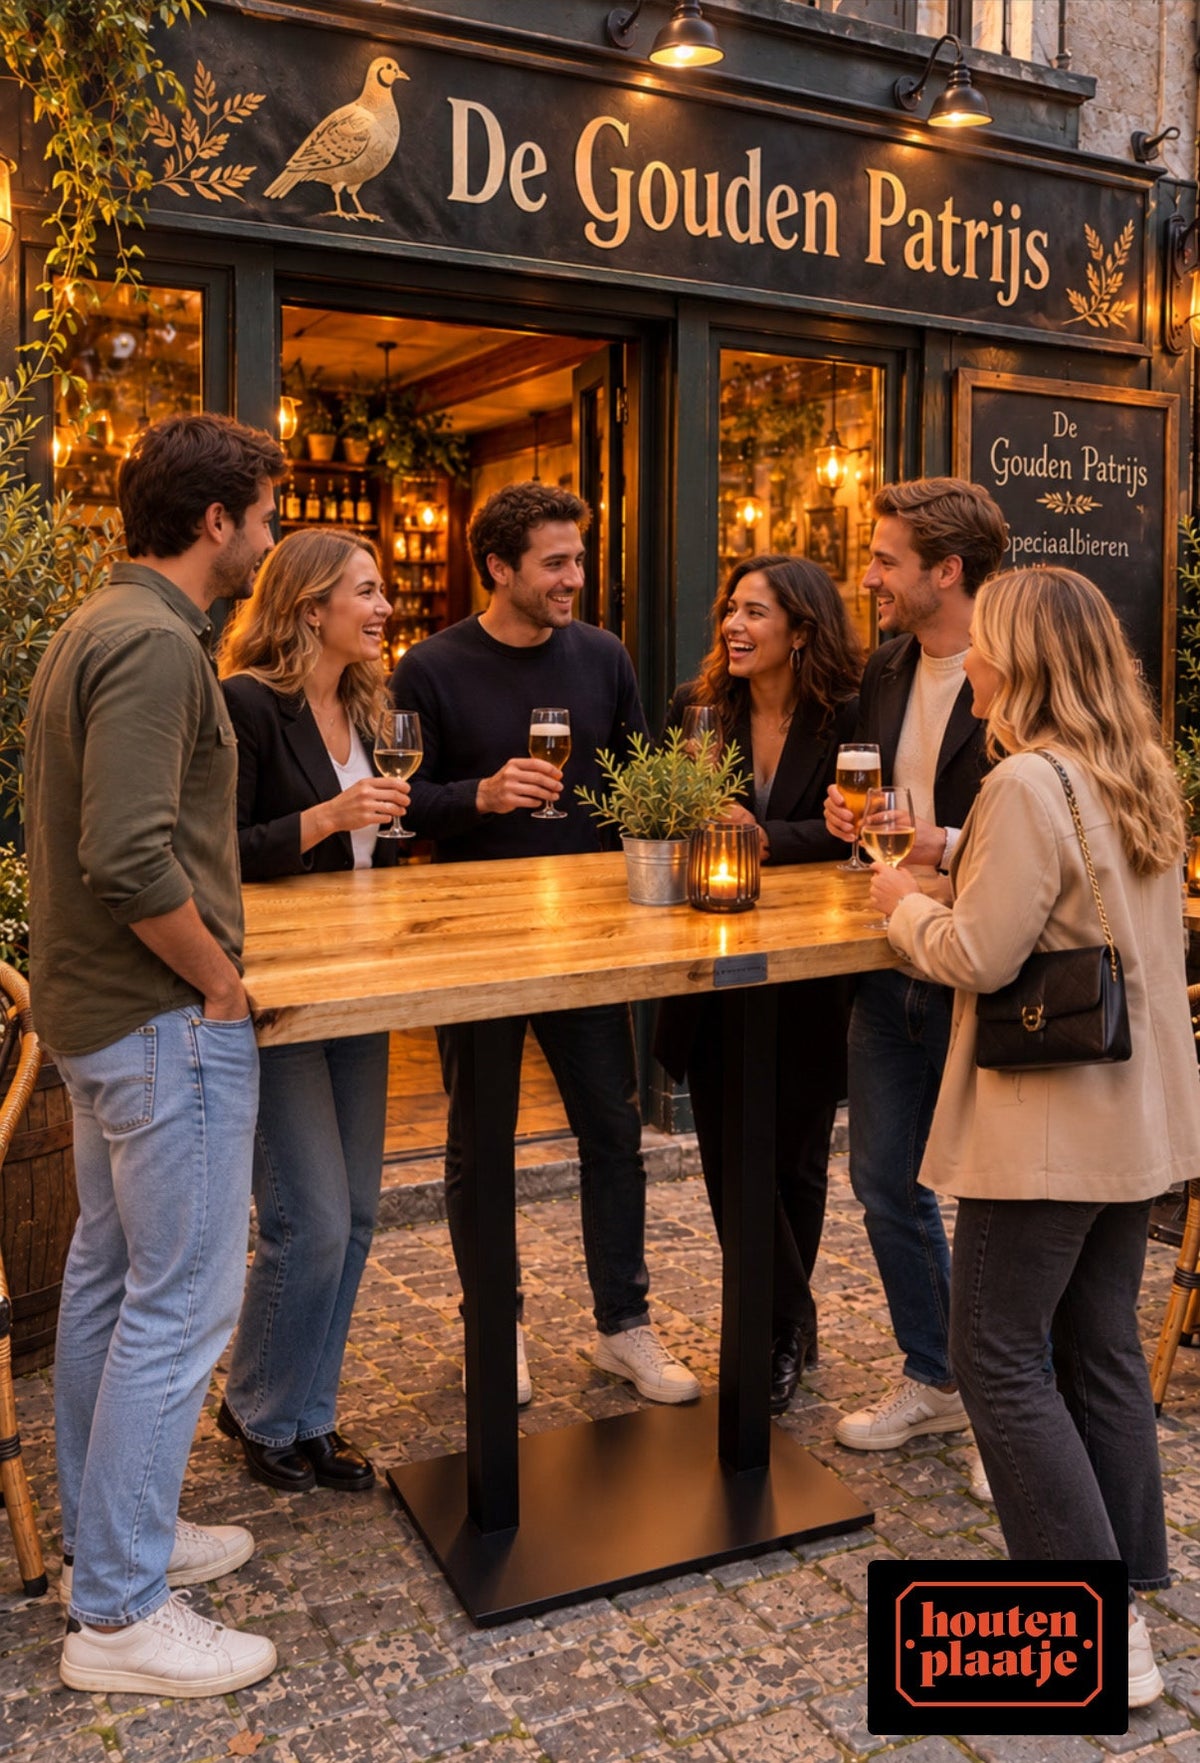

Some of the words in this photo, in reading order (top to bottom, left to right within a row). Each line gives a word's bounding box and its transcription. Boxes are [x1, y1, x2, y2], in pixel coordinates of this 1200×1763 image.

[447, 97, 548, 212] De
[575, 116, 840, 258] Gouden
[864, 168, 1051, 307] Patrijs
[1052, 411, 1078, 438] De
[990, 437, 1072, 486] Gouden
[1081, 446, 1148, 498] Patrijs
